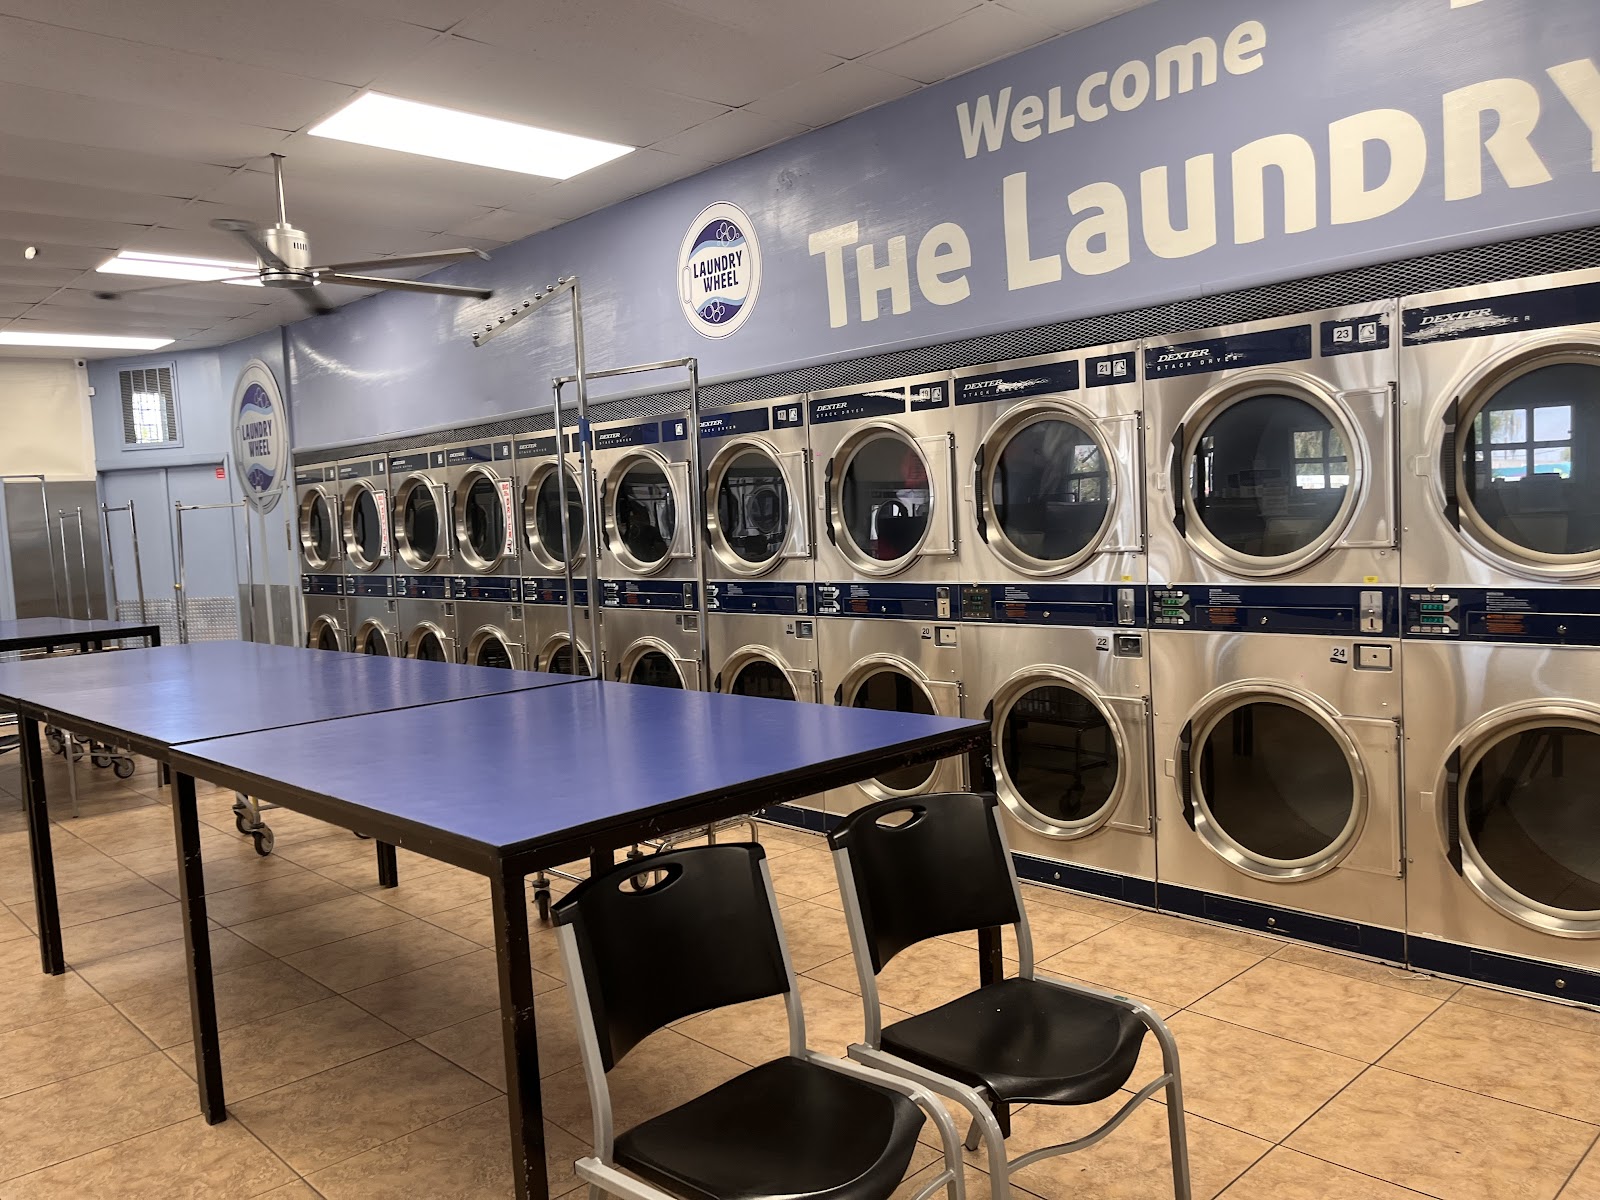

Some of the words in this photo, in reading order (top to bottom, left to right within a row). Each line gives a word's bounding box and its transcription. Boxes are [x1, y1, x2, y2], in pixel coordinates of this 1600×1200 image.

[693, 250, 742, 278] LAUNDRY
[703, 270, 738, 293] WHEEL
[1419, 308, 1492, 325] DEXTER
[1336, 330, 1349, 339] 23
[1157, 349, 1210, 363] DEXTER
[1099, 364, 1108, 372] 21
[1157, 362, 1191, 371] STACK
[963, 379, 1003, 391] DEXTER
[963, 390, 990, 398] STACK
[816, 402, 848, 411] DEXTER
[816, 411, 837, 419] STACK
[242, 420, 272, 440] LAUNDRY
[248, 439, 271, 457] WHEEL
[1098, 638, 1107, 646] 22
[1333, 648, 1345, 657] 24
